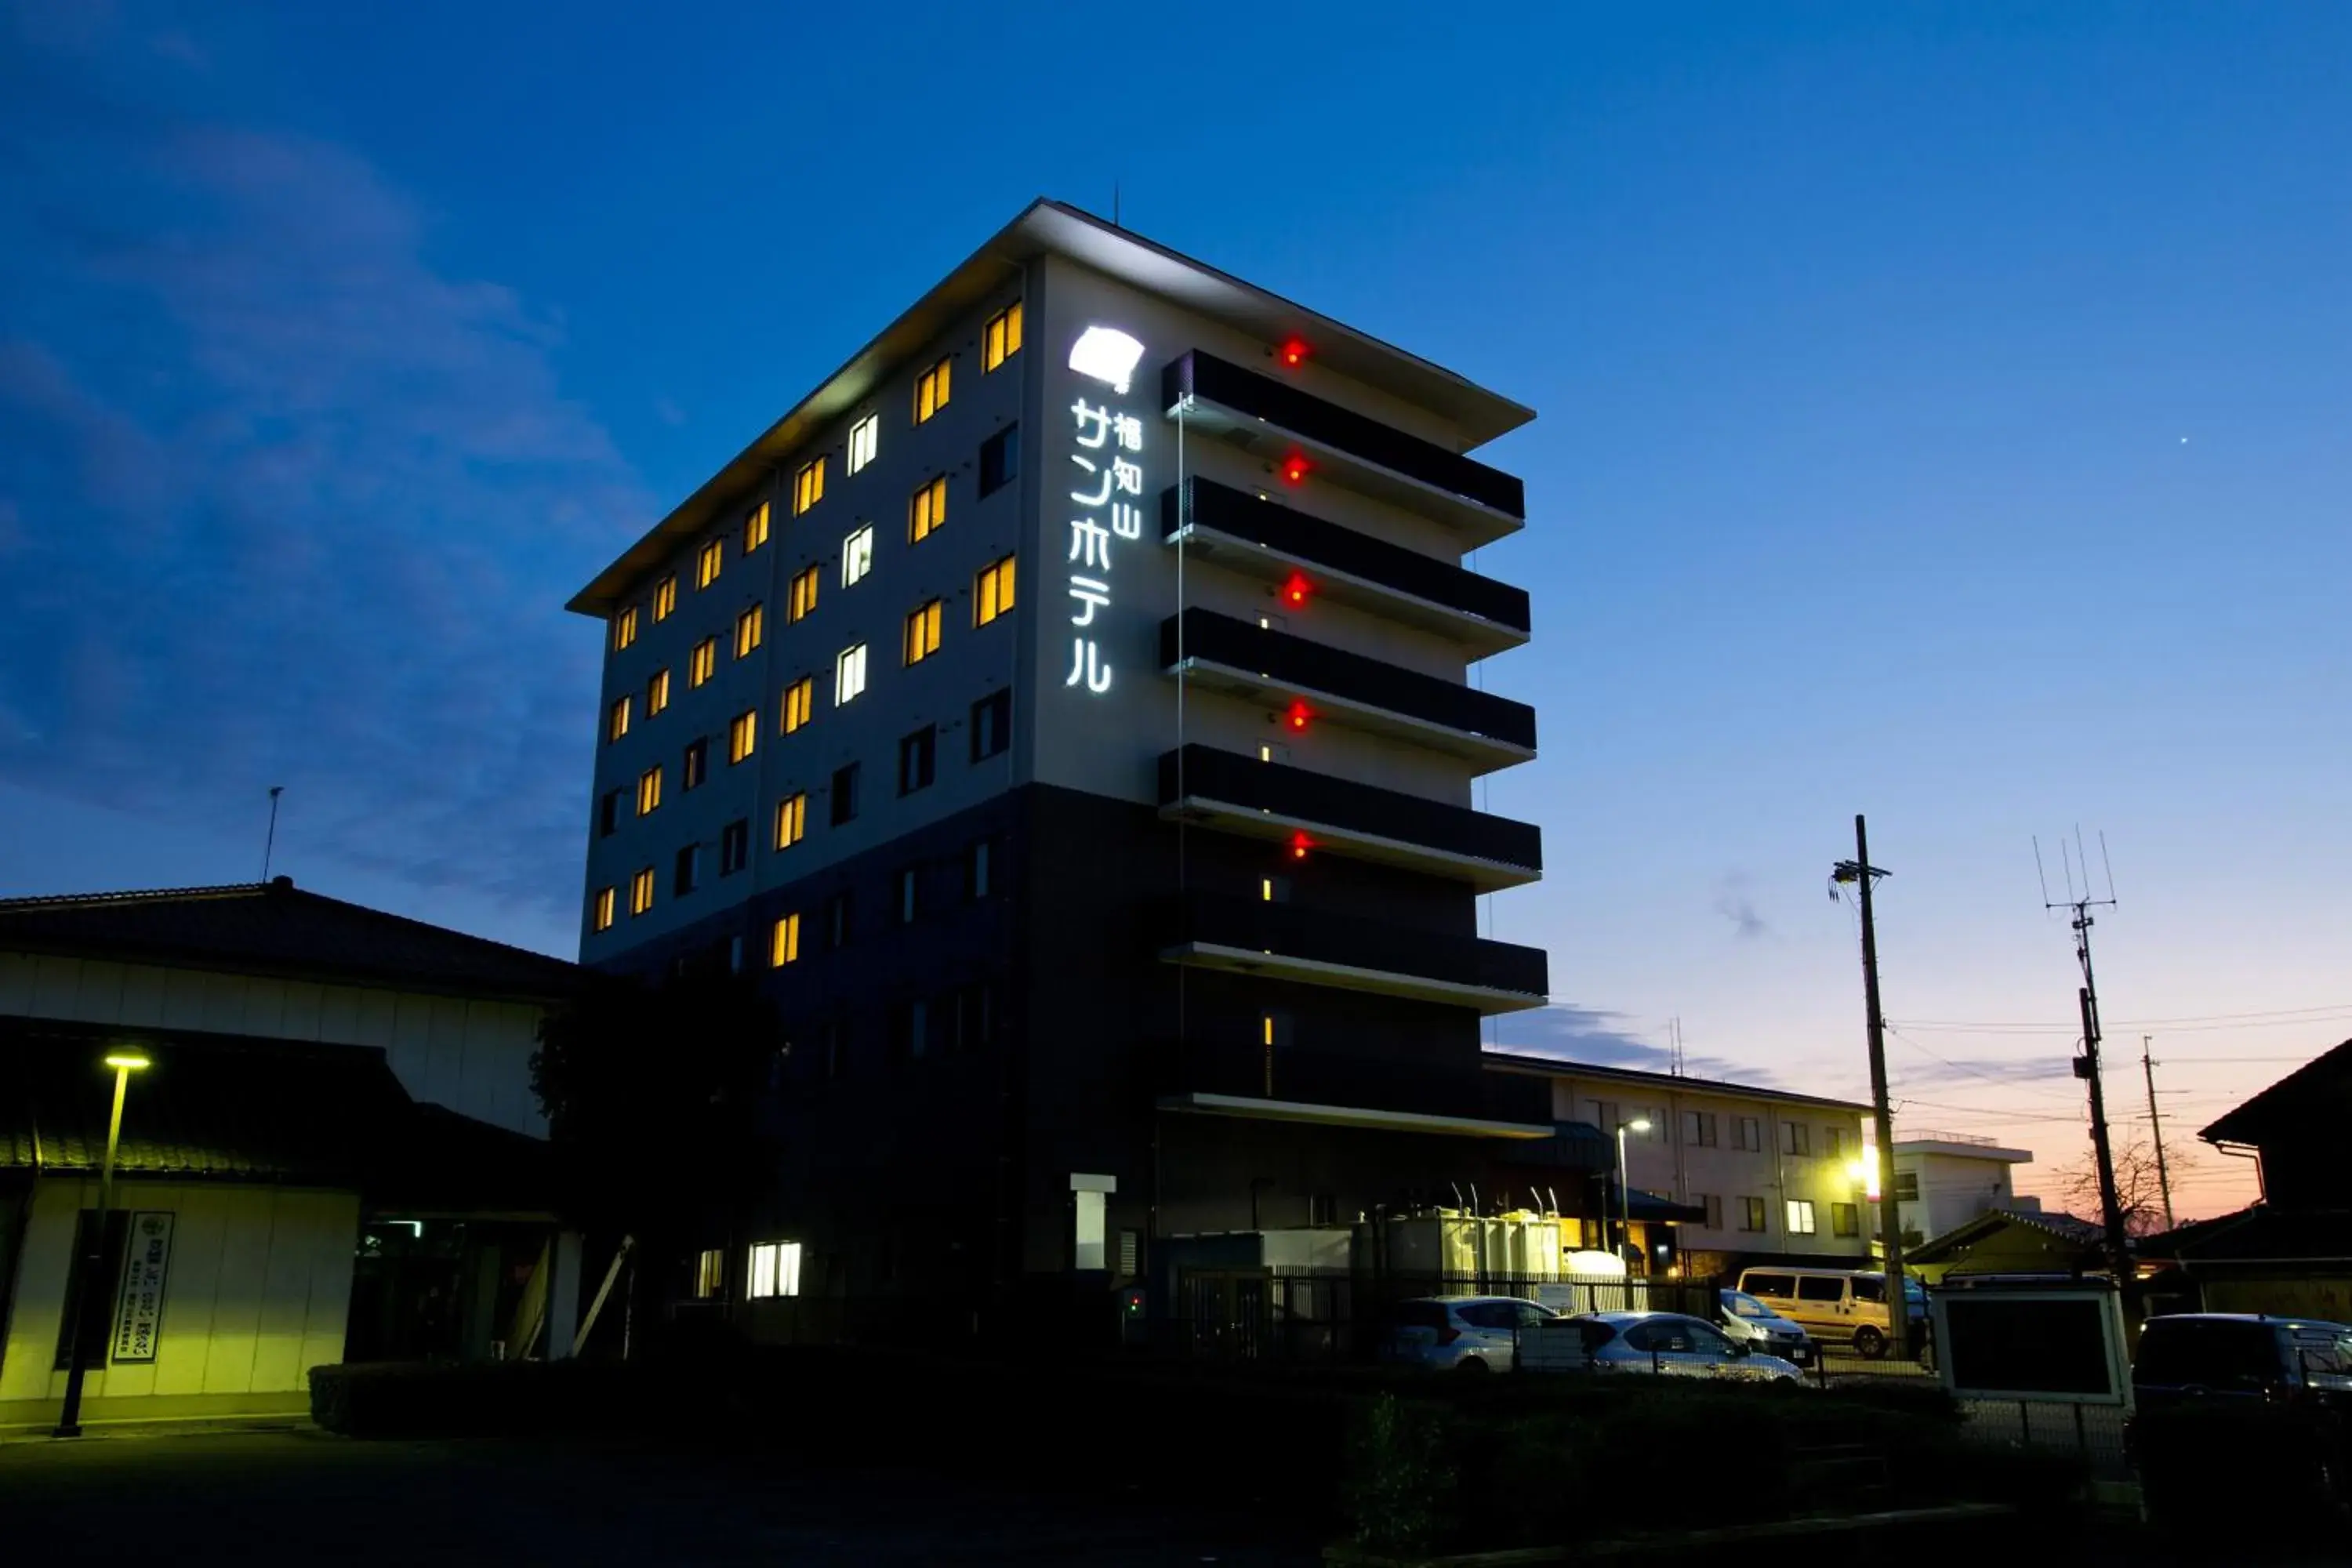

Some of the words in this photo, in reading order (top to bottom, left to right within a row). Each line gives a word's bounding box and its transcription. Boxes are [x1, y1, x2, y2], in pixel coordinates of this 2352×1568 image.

[1065, 397, 1112, 694] サンホテル
[1112, 412, 1142, 540] 福知山
